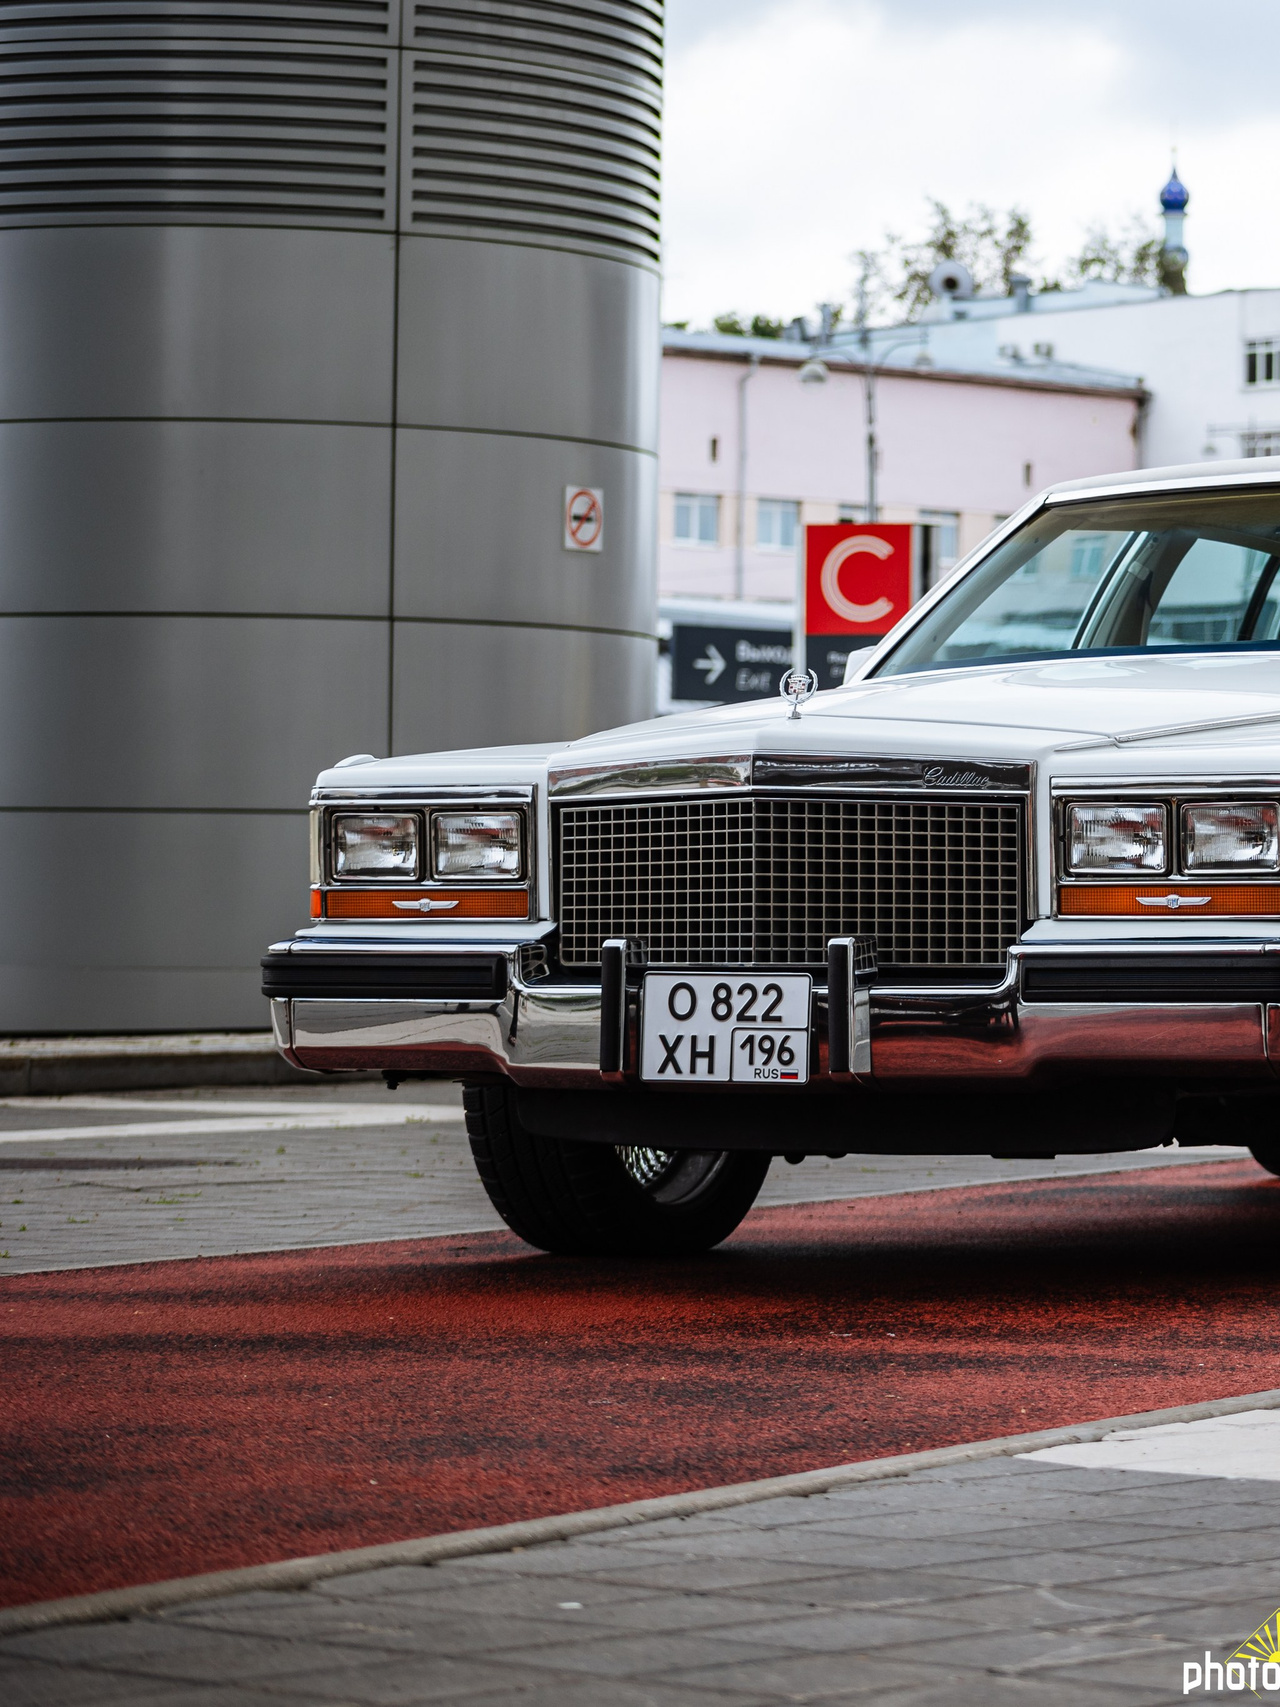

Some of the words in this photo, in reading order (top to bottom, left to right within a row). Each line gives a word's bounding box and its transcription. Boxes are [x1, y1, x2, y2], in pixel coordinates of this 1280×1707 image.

[735, 640, 792, 666] Выхо
[923, 766, 990, 789] Cadillac
[711, 982, 784, 1022] 822
[739, 1033, 795, 1066] 196
[753, 1067, 779, 1079] RUS
